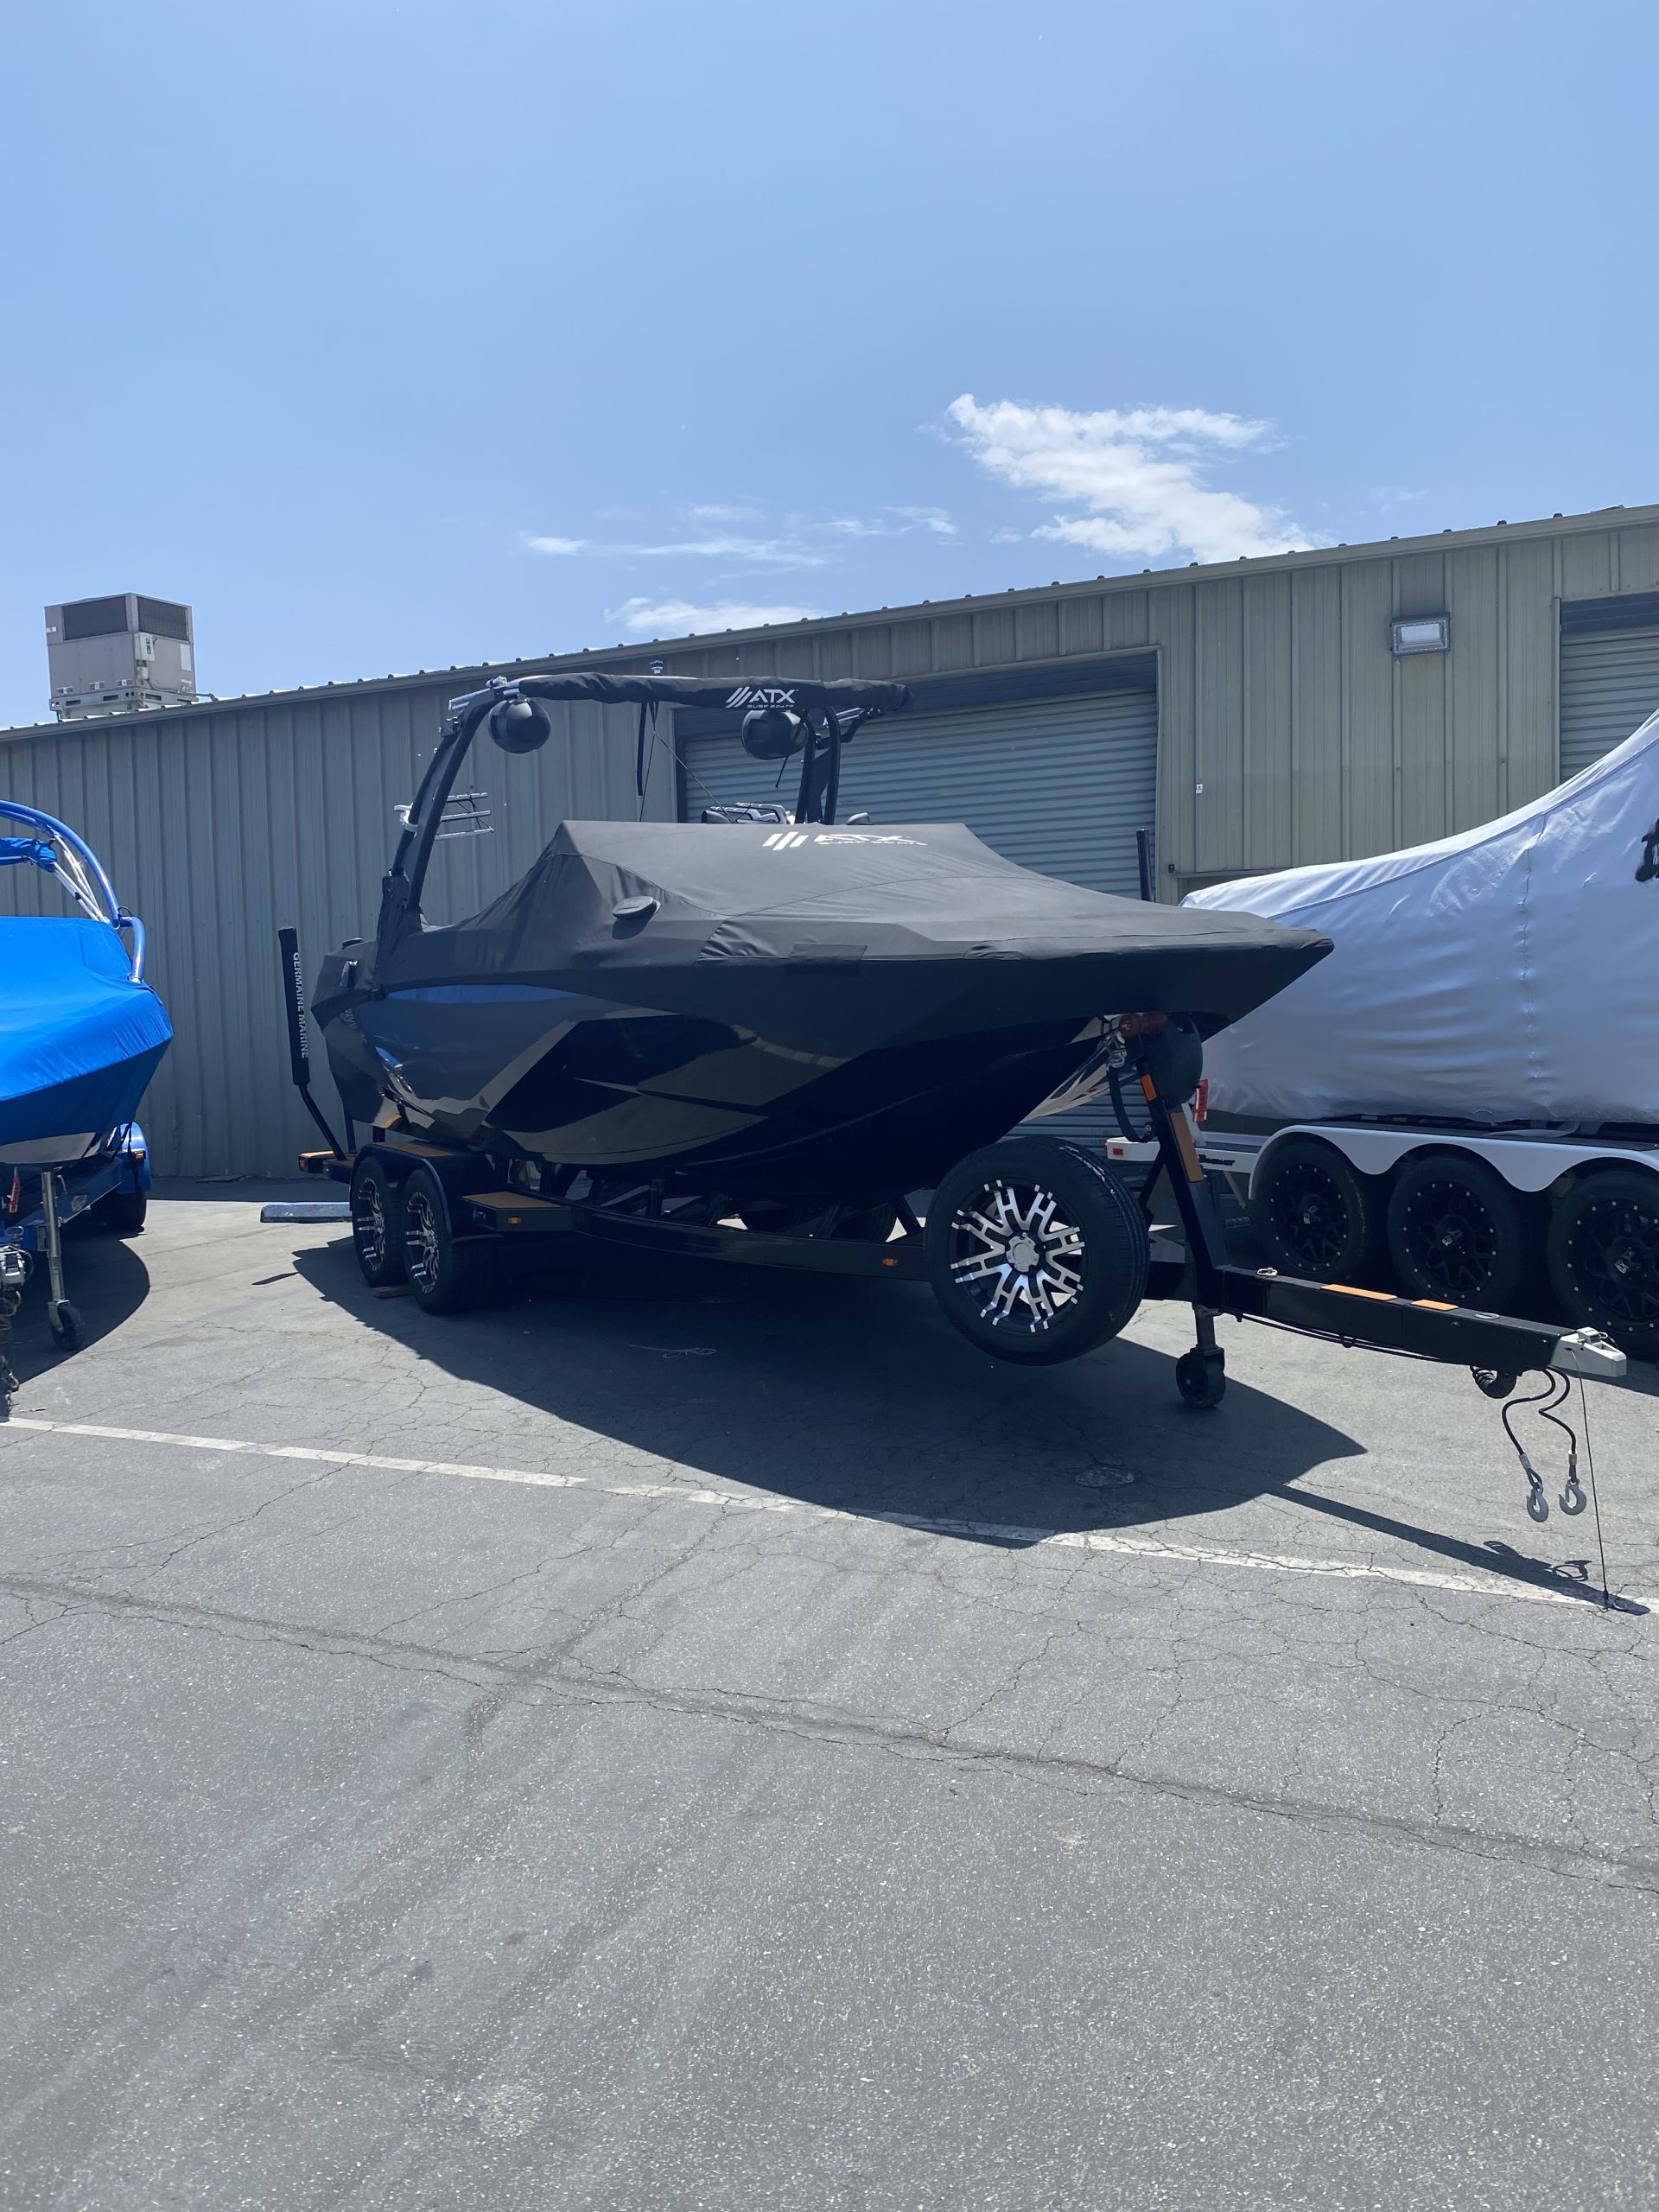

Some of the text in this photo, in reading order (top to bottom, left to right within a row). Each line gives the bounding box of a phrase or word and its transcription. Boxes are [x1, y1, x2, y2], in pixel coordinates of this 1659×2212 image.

[748, 689, 796, 703] ATX
[293, 951, 308, 1058] GERMAINE MARINE
